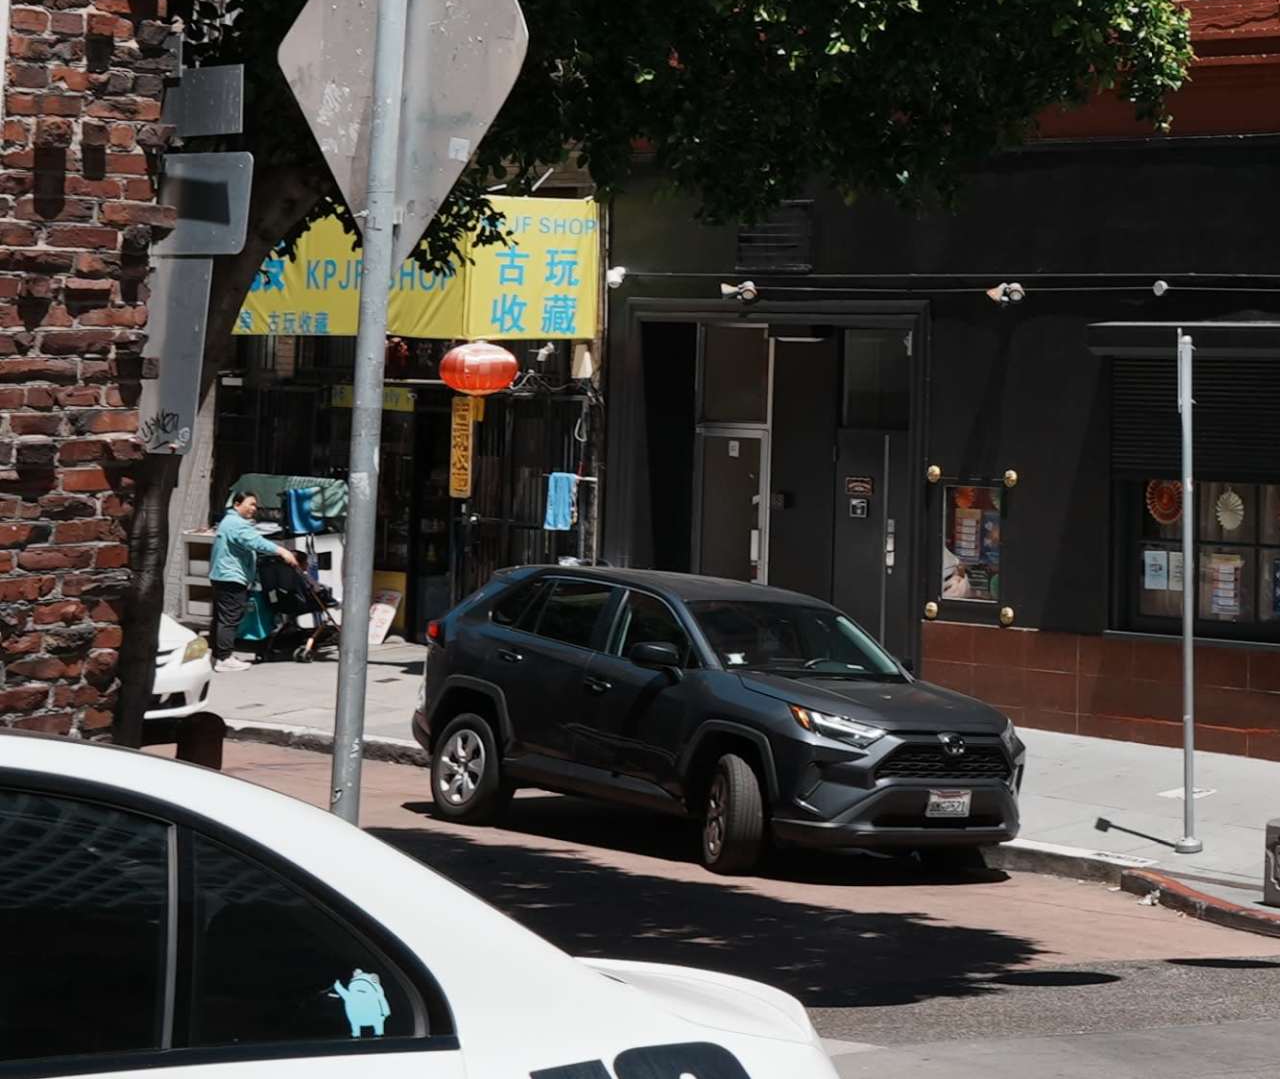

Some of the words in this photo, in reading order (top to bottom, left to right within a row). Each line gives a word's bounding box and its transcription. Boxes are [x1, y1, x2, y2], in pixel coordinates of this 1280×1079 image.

[539, 215, 597, 236] SHOP
[495, 245, 581, 288] 古玩
[490, 293, 578, 334] 收藏
